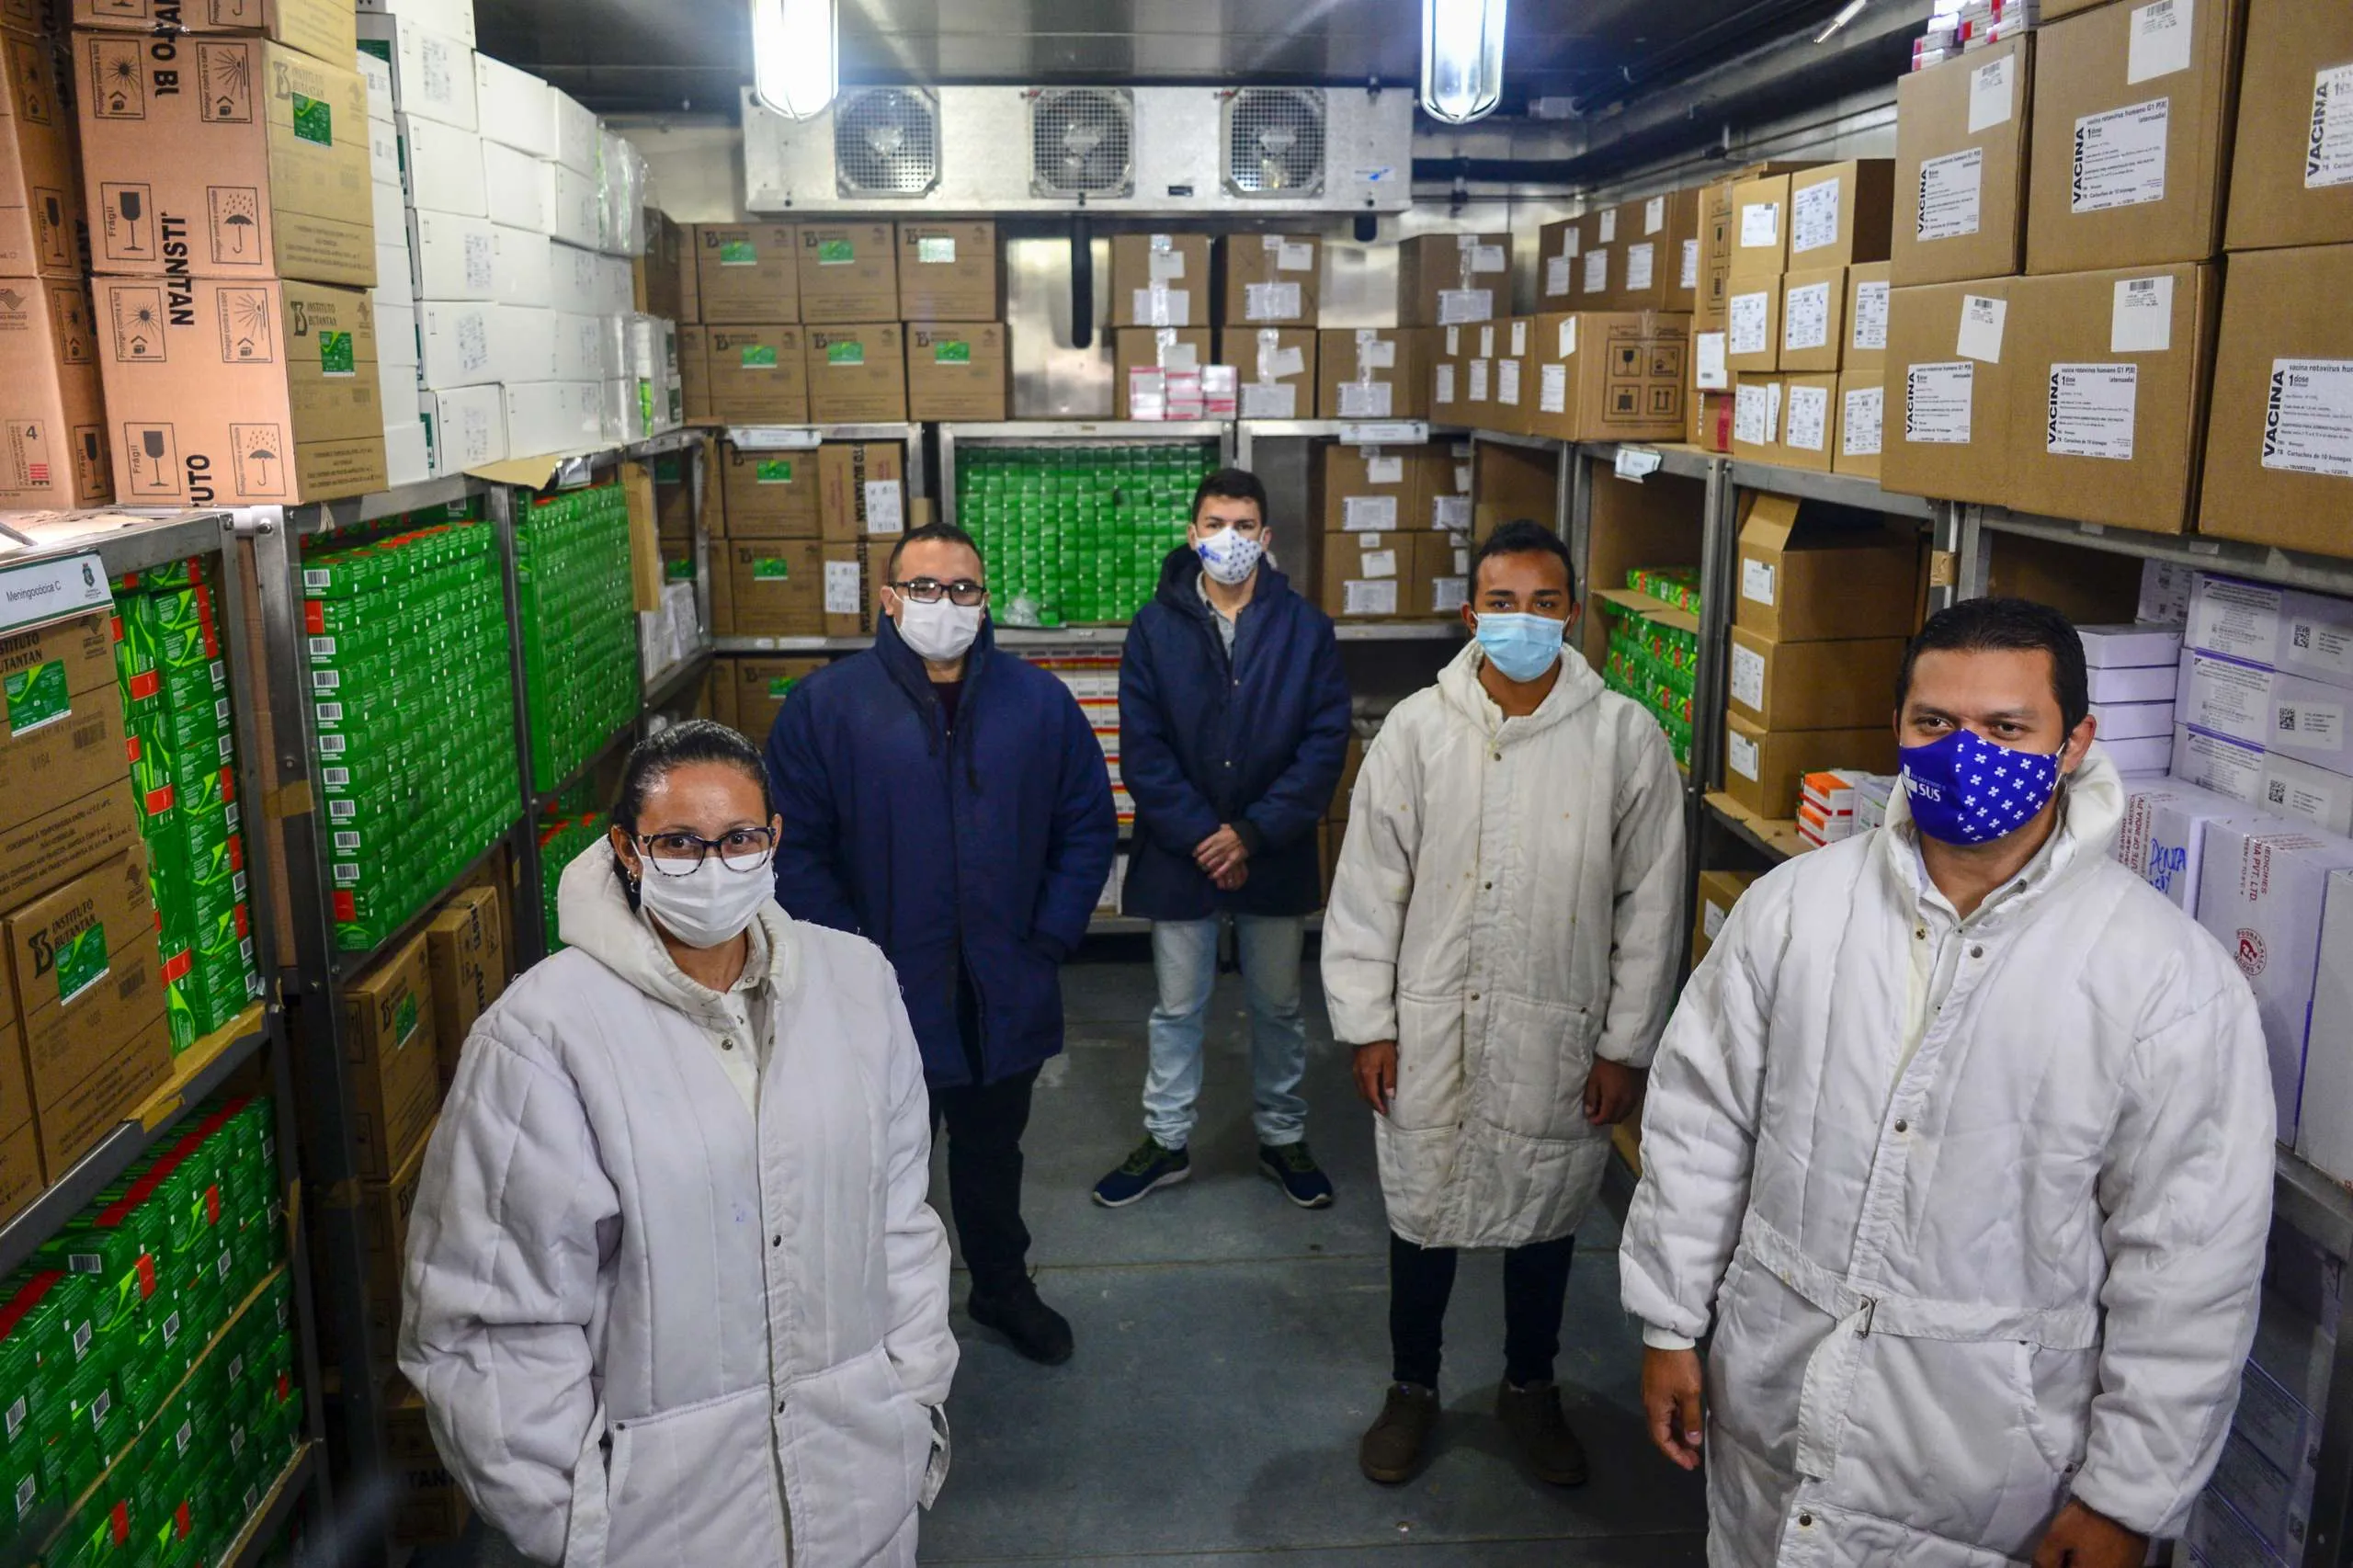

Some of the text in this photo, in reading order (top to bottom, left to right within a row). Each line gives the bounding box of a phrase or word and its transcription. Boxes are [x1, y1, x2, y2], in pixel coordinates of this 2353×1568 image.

[2307, 81, 2328, 176] VACINA
[2074, 127, 2084, 204] VACINA
[1918, 169, 1927, 234] VACINA
[1906, 371, 1915, 434] VACINA
[2049, 372, 2059, 444] VACINA
[2062, 376, 2065, 386] 1
[2289, 374, 2293, 386] 1
[2264, 370, 2284, 457] VACINA
[130, 445, 141, 474] Frágil
[55, 580, 62, 591] C
[1918, 783, 1941, 802] SUS
